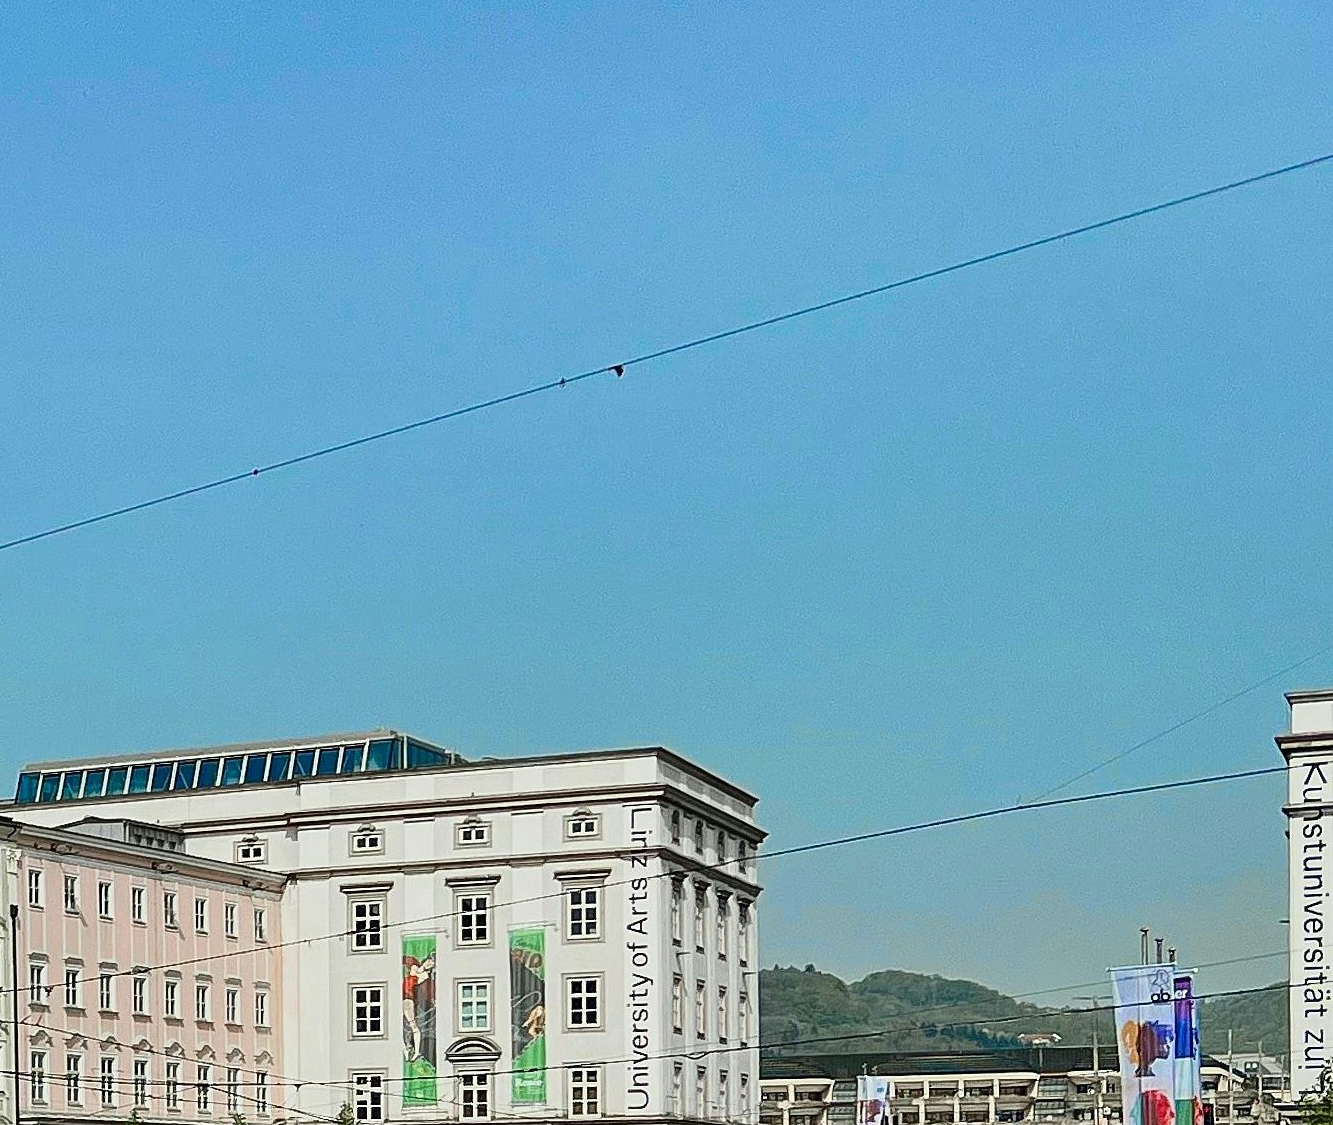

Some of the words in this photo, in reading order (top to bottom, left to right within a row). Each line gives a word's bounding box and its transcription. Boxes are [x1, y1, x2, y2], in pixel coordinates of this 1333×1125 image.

[626, 876, 649, 936] Arts
[1302, 761, 1331, 1018] Kunstuniversität
[626, 941, 649, 967] of
[627, 972, 654, 1111] University
